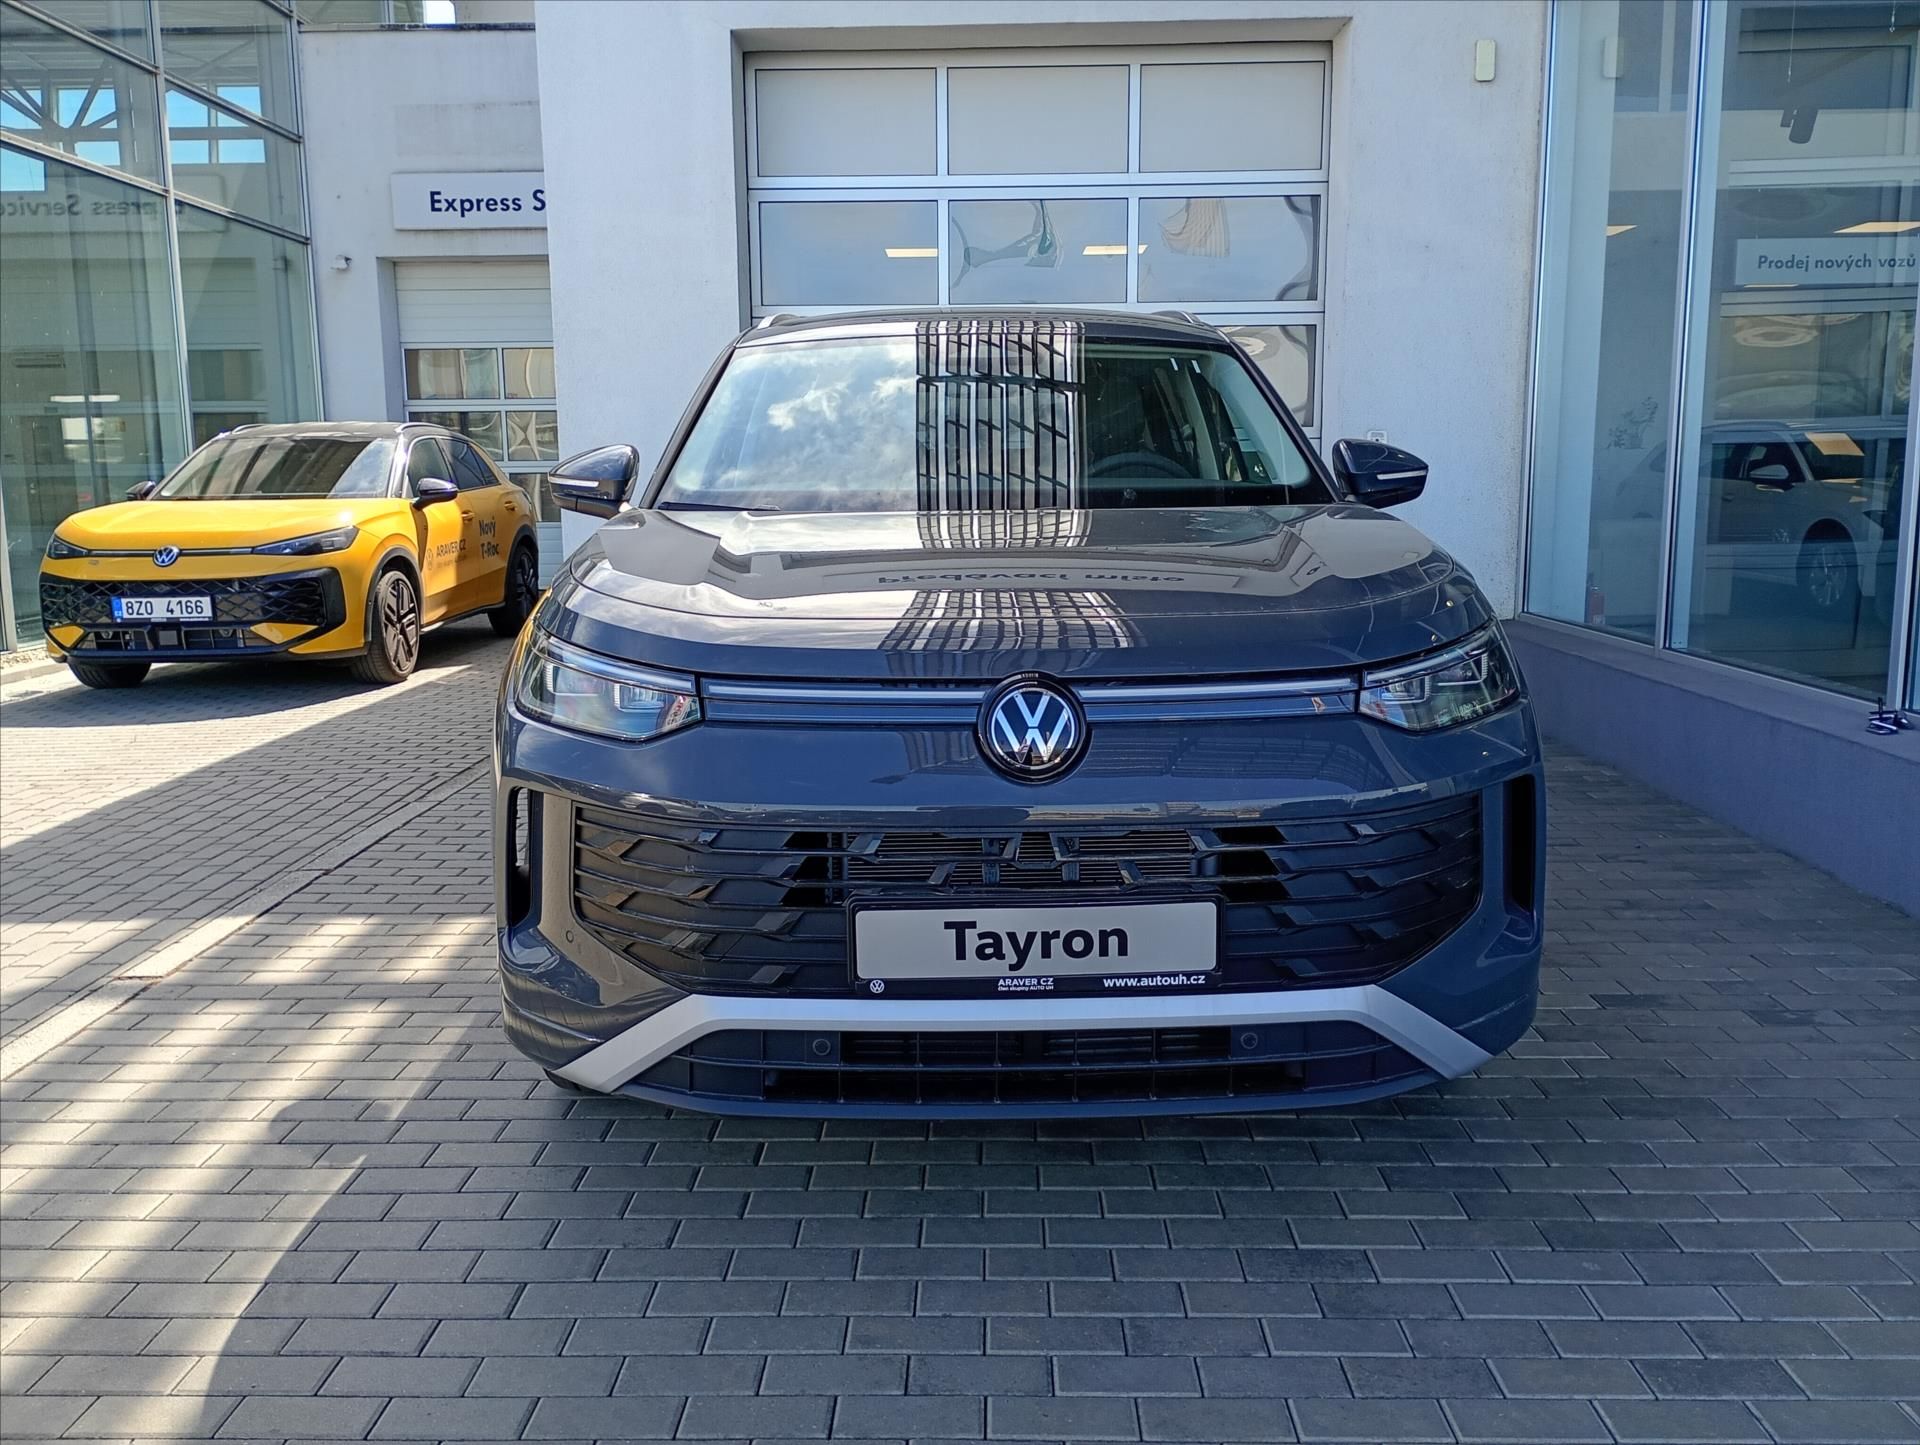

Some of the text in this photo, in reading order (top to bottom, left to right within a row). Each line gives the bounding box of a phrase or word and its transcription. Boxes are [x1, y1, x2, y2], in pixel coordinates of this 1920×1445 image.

[429, 190, 522, 218] Express
[1757, 253, 1916, 272] Prodej nových vozů
[479, 516, 496, 537] Nový
[436, 541, 460, 557] ARAVER
[480, 541, 499, 560] T-Roc
[166, 599, 204, 616] 4166
[943, 920, 1129, 972] Tayron
[998, 977, 1054, 986] ARAVER CZ
[1103, 974, 1205, 988] www.autouh.cz
